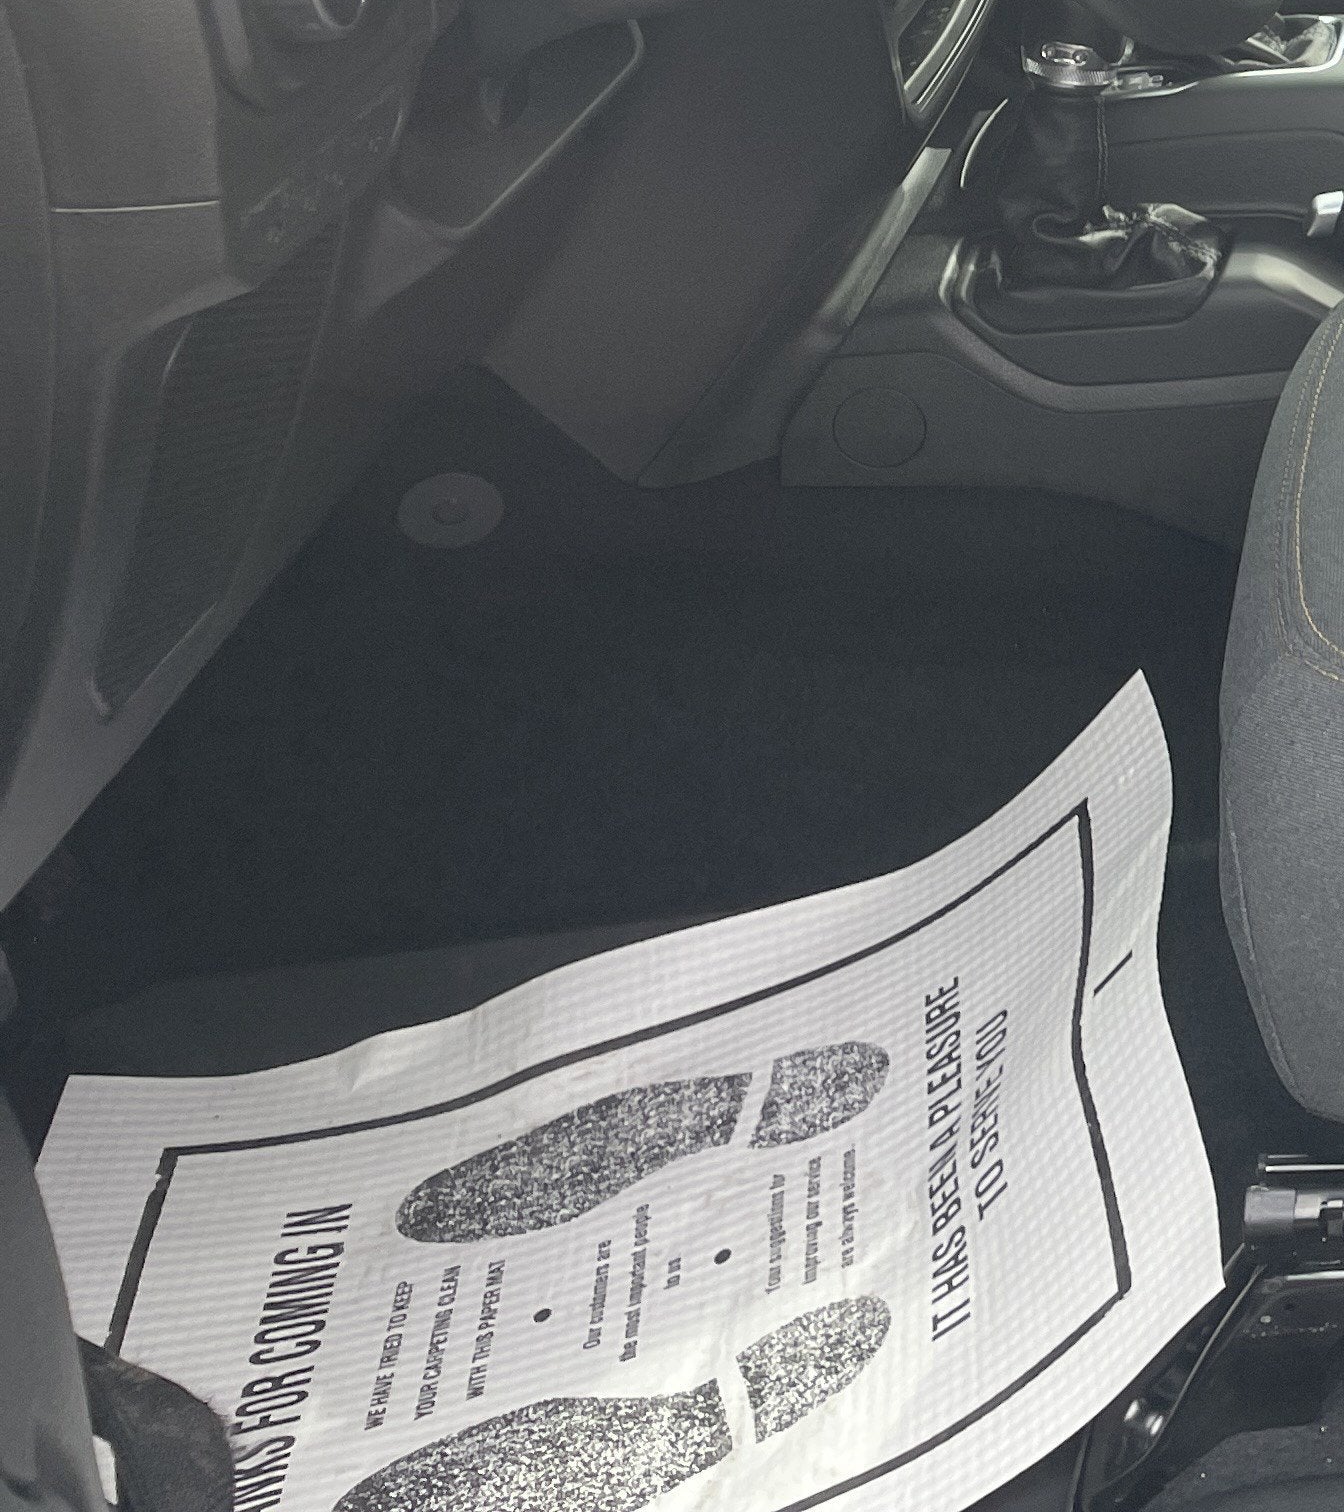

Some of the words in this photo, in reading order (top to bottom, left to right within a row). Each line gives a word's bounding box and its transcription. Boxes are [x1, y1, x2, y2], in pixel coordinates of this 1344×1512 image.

[925, 976, 963, 1129] PLEASURE
[975, 1009, 1008, 1079] YOU
[929, 1114, 963, 1152] A
[970, 1064, 1003, 1169] SERVE
[769, 1173, 786, 1190] for
[807, 1156, 822, 1198] service
[840, 1143, 856, 1201] welcome.
[928, 1141, 963, 1236] BEEN
[977, 1158, 1008, 1221] TO
[280, 1203, 353, 1238] IN
[632, 1204, 651, 1246] people
[767, 1190, 786, 1263] suggestions
[806, 1201, 820, 1220] our
[838, 1202, 859, 1245] always
[597, 1240, 612, 1261] are
[667, 1257, 682, 1273] us
[802, 1220, 822, 1286] improving
[841, 1246, 855, 1269] are
[932, 1224, 970, 1304] HAS
[437, 1265, 462, 1307] CLEAN
[485, 1259, 505, 1287] MAT
[628, 1247, 647, 1307] important
[663, 1273, 681, 1290] to
[765, 1265, 782, 1294] Your
[248, 1241, 346, 1365] COMING
[392, 1281, 414, 1313] KEEP
[478, 1287, 501, 1331] PAPER
[589, 1263, 610, 1324] customers
[387, 1313, 407, 1333] TO
[582, 1327, 602, 1350] Our
[624, 1307, 641, 1338] most
[932, 1298, 971, 1341] IT
[378, 1333, 402, 1371] TRIED
[422, 1308, 454, 1380] CARPETING
[471, 1331, 494, 1364] THIS
[619, 1340, 638, 1362] the
[231, 1365, 315, 1435] FOR
[370, 1371, 395, 1407] HAVE
[414, 1381, 438, 1421] YOUR
[466, 1364, 488, 1401] WITH
[364, 1406, 387, 1431] WE
